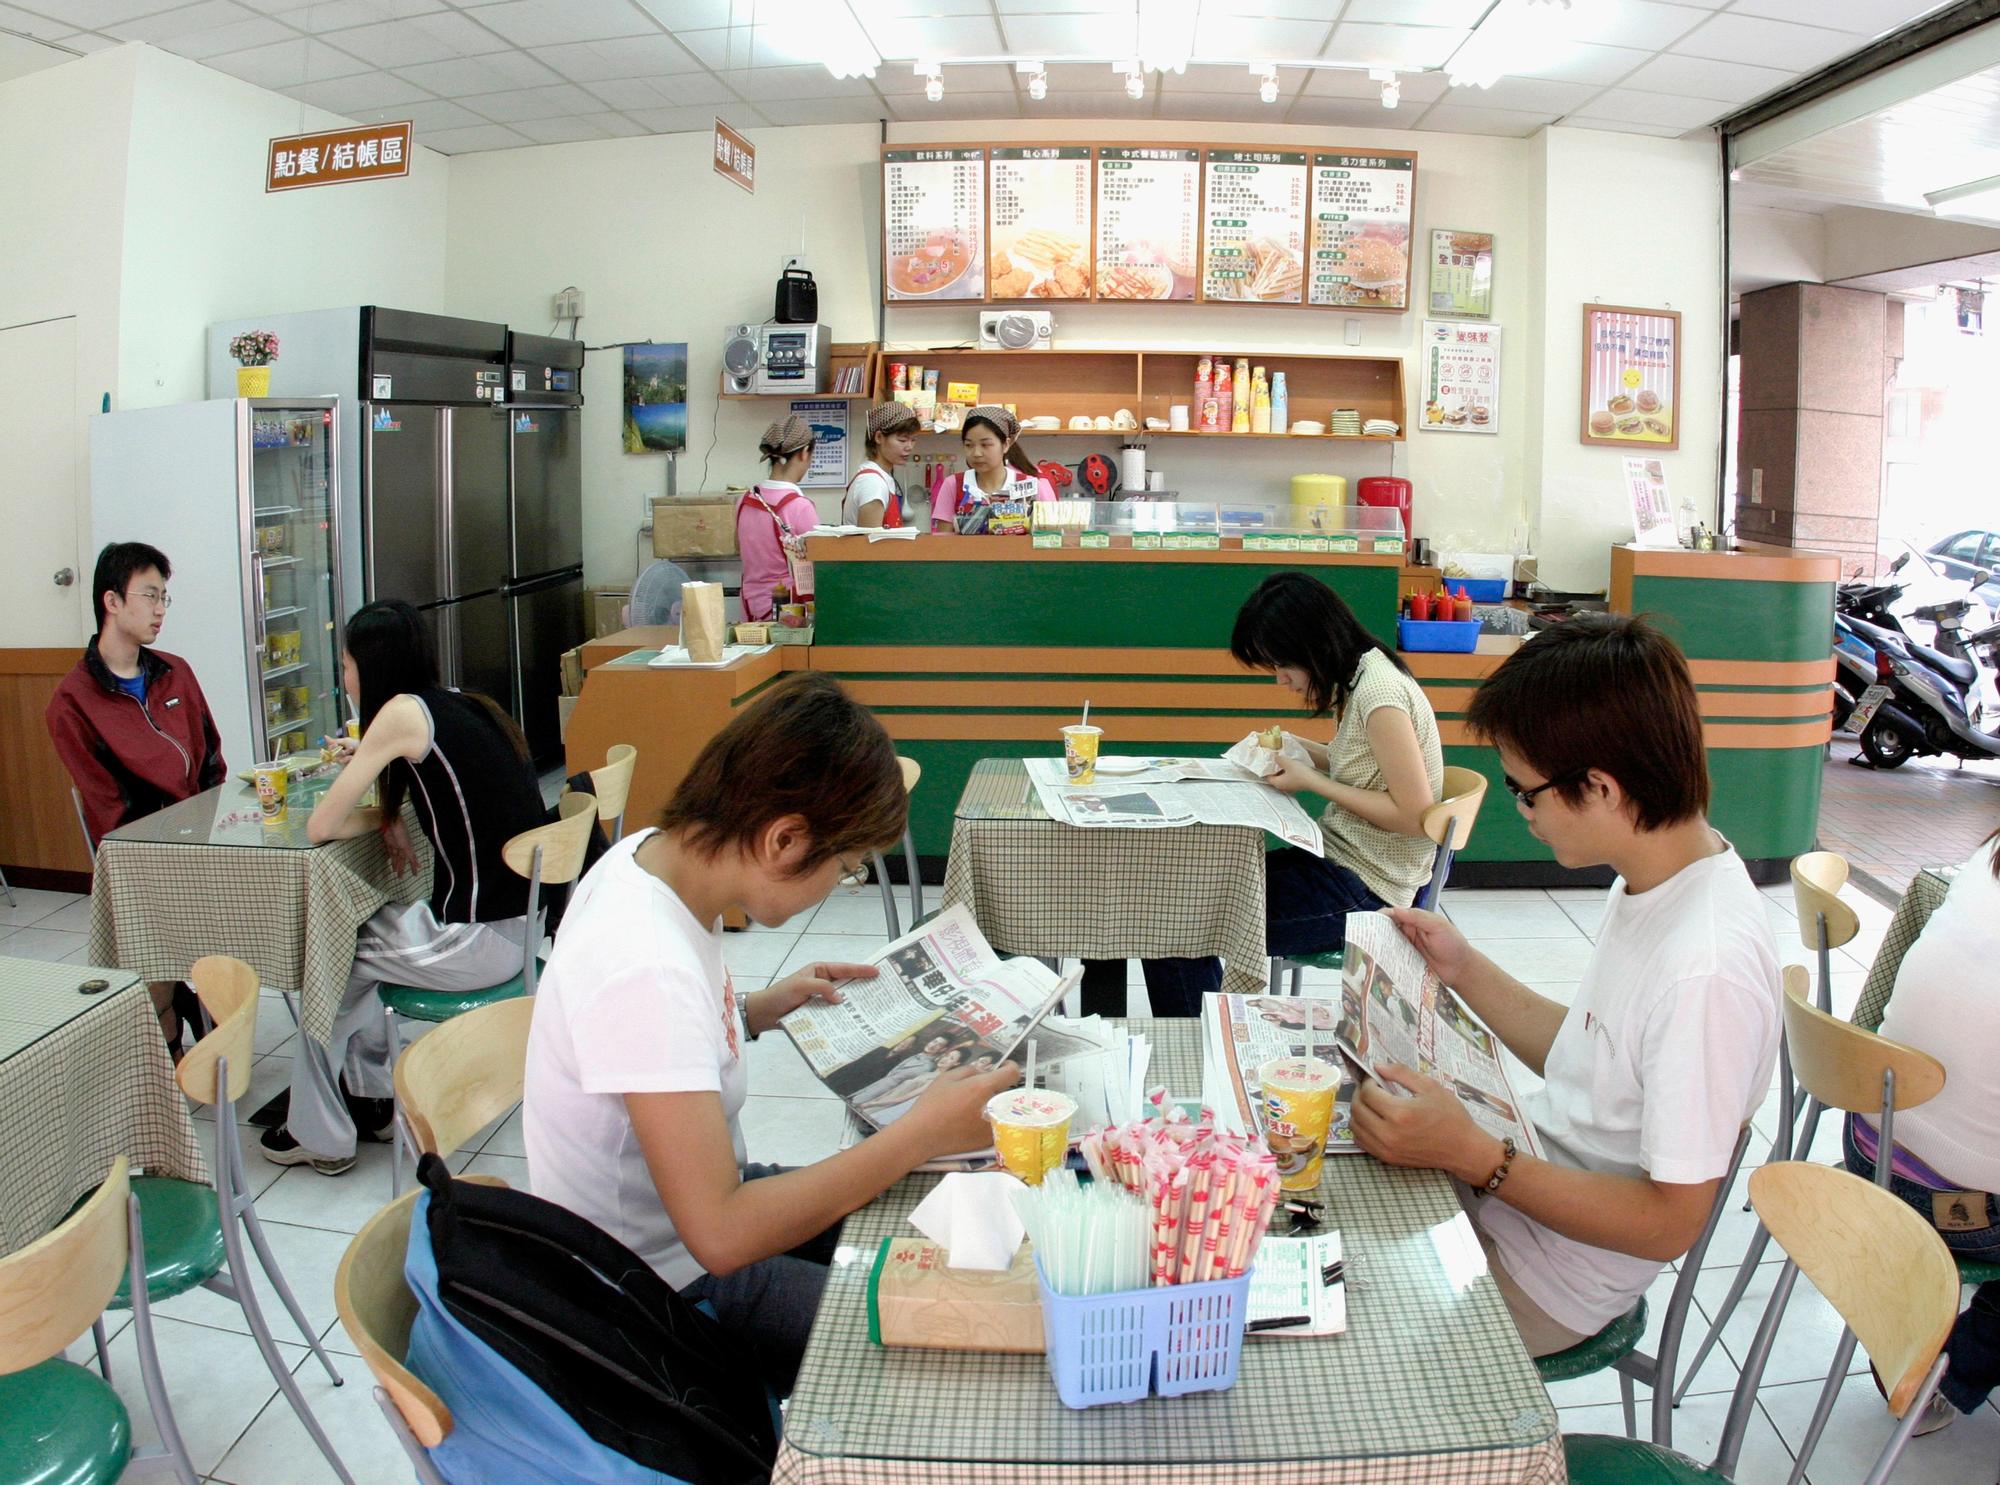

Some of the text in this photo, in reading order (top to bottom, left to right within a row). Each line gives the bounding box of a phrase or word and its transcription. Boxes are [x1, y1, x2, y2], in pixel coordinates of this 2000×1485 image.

[274, 136, 404, 178] 點餐/結帳區
[916, 151, 953, 161] 飲料系列
[1022, 149, 1060, 158] 點心系列
